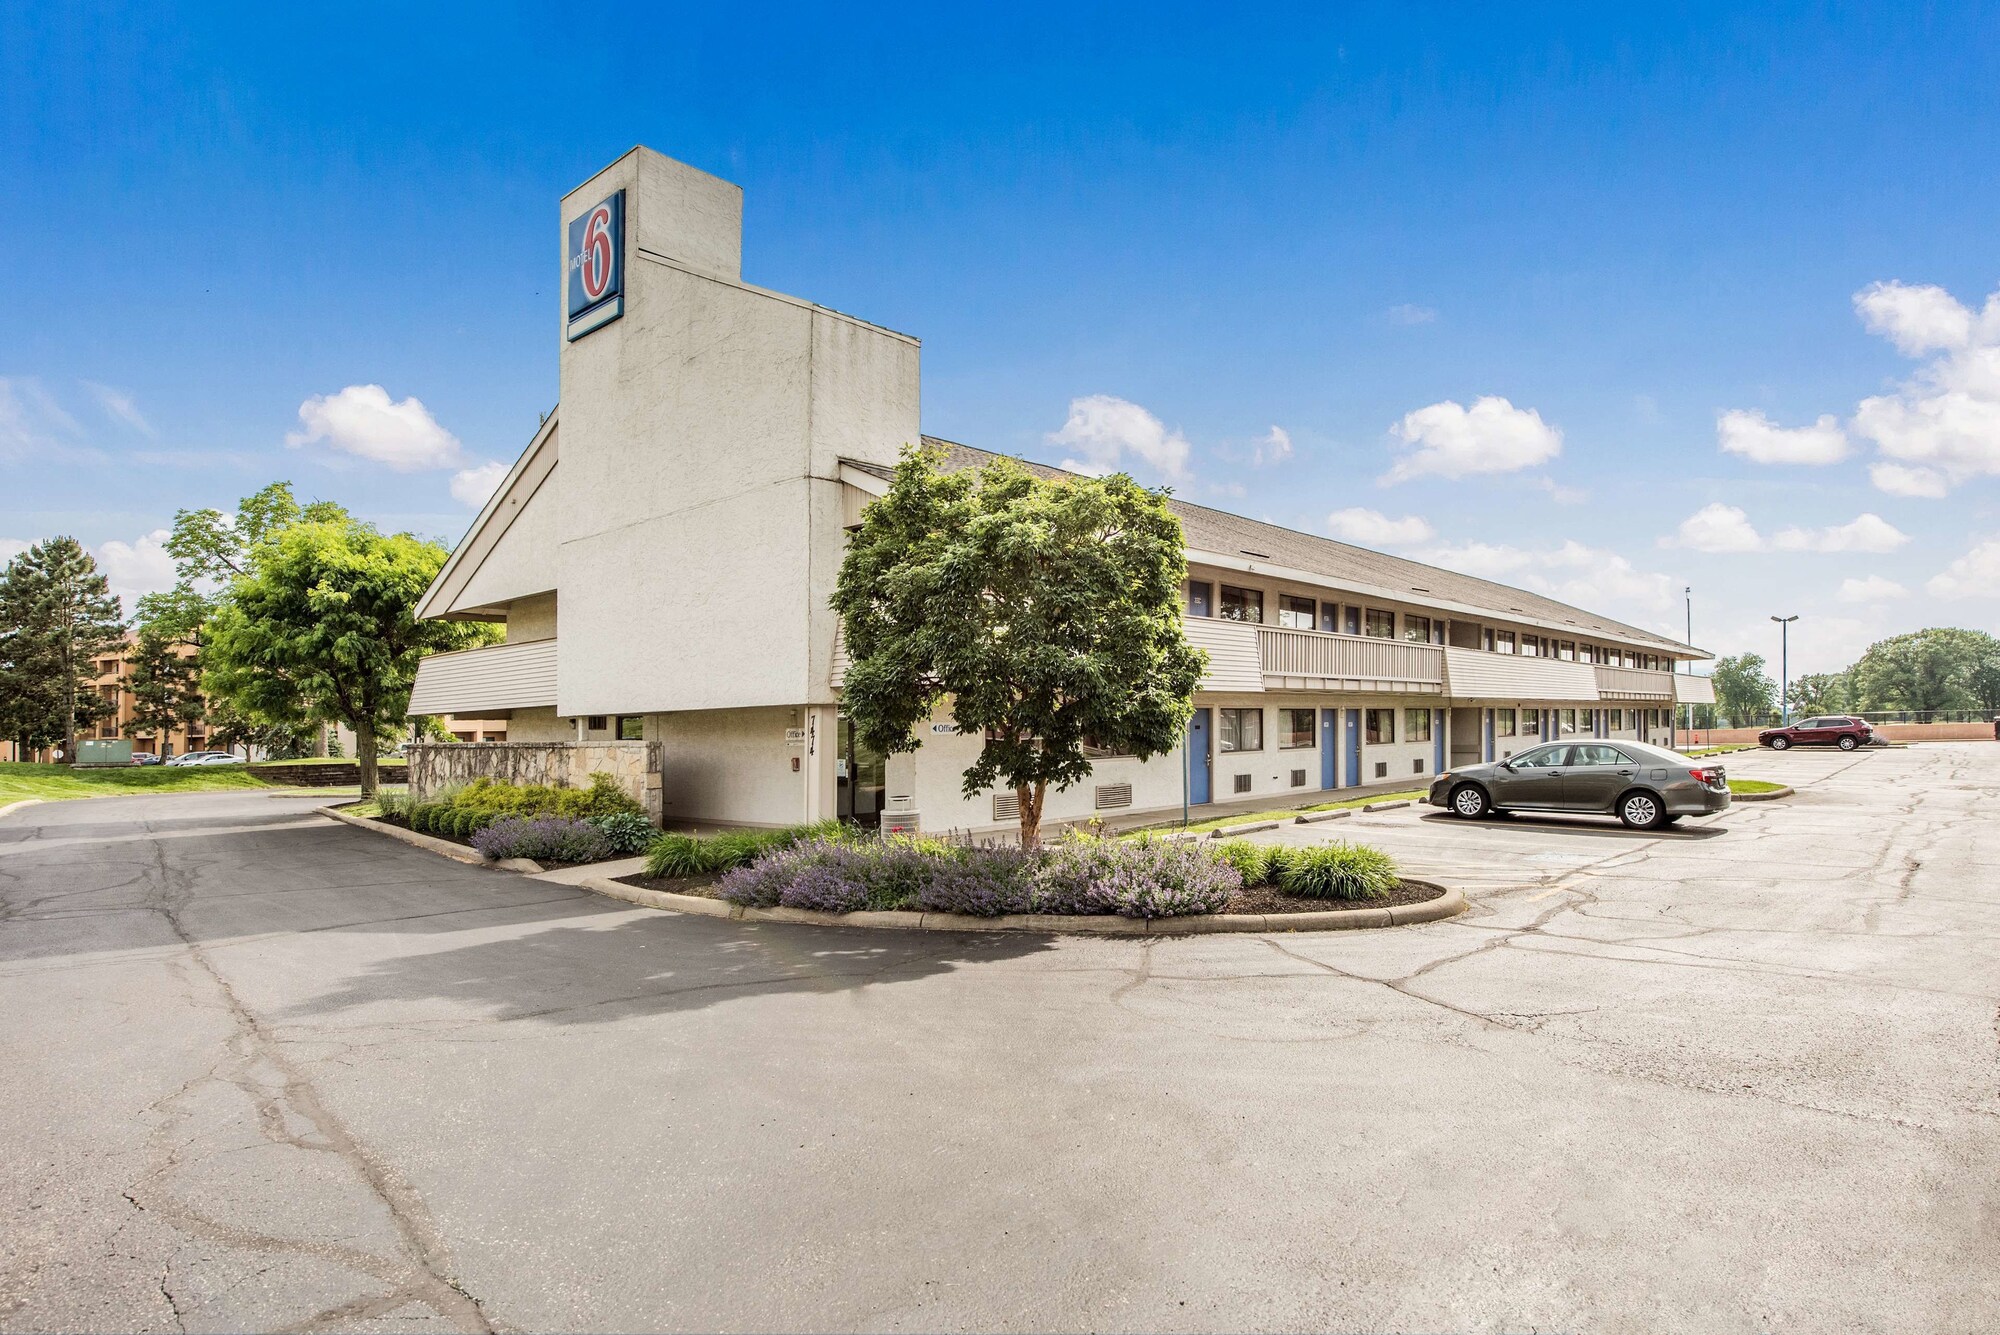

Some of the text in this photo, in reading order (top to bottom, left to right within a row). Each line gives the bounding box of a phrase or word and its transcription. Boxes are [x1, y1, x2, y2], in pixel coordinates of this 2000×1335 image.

[569, 206, 613, 301] MOTEL 6
[938, 724, 955, 733] Offic
[786, 730, 801, 738] Office
